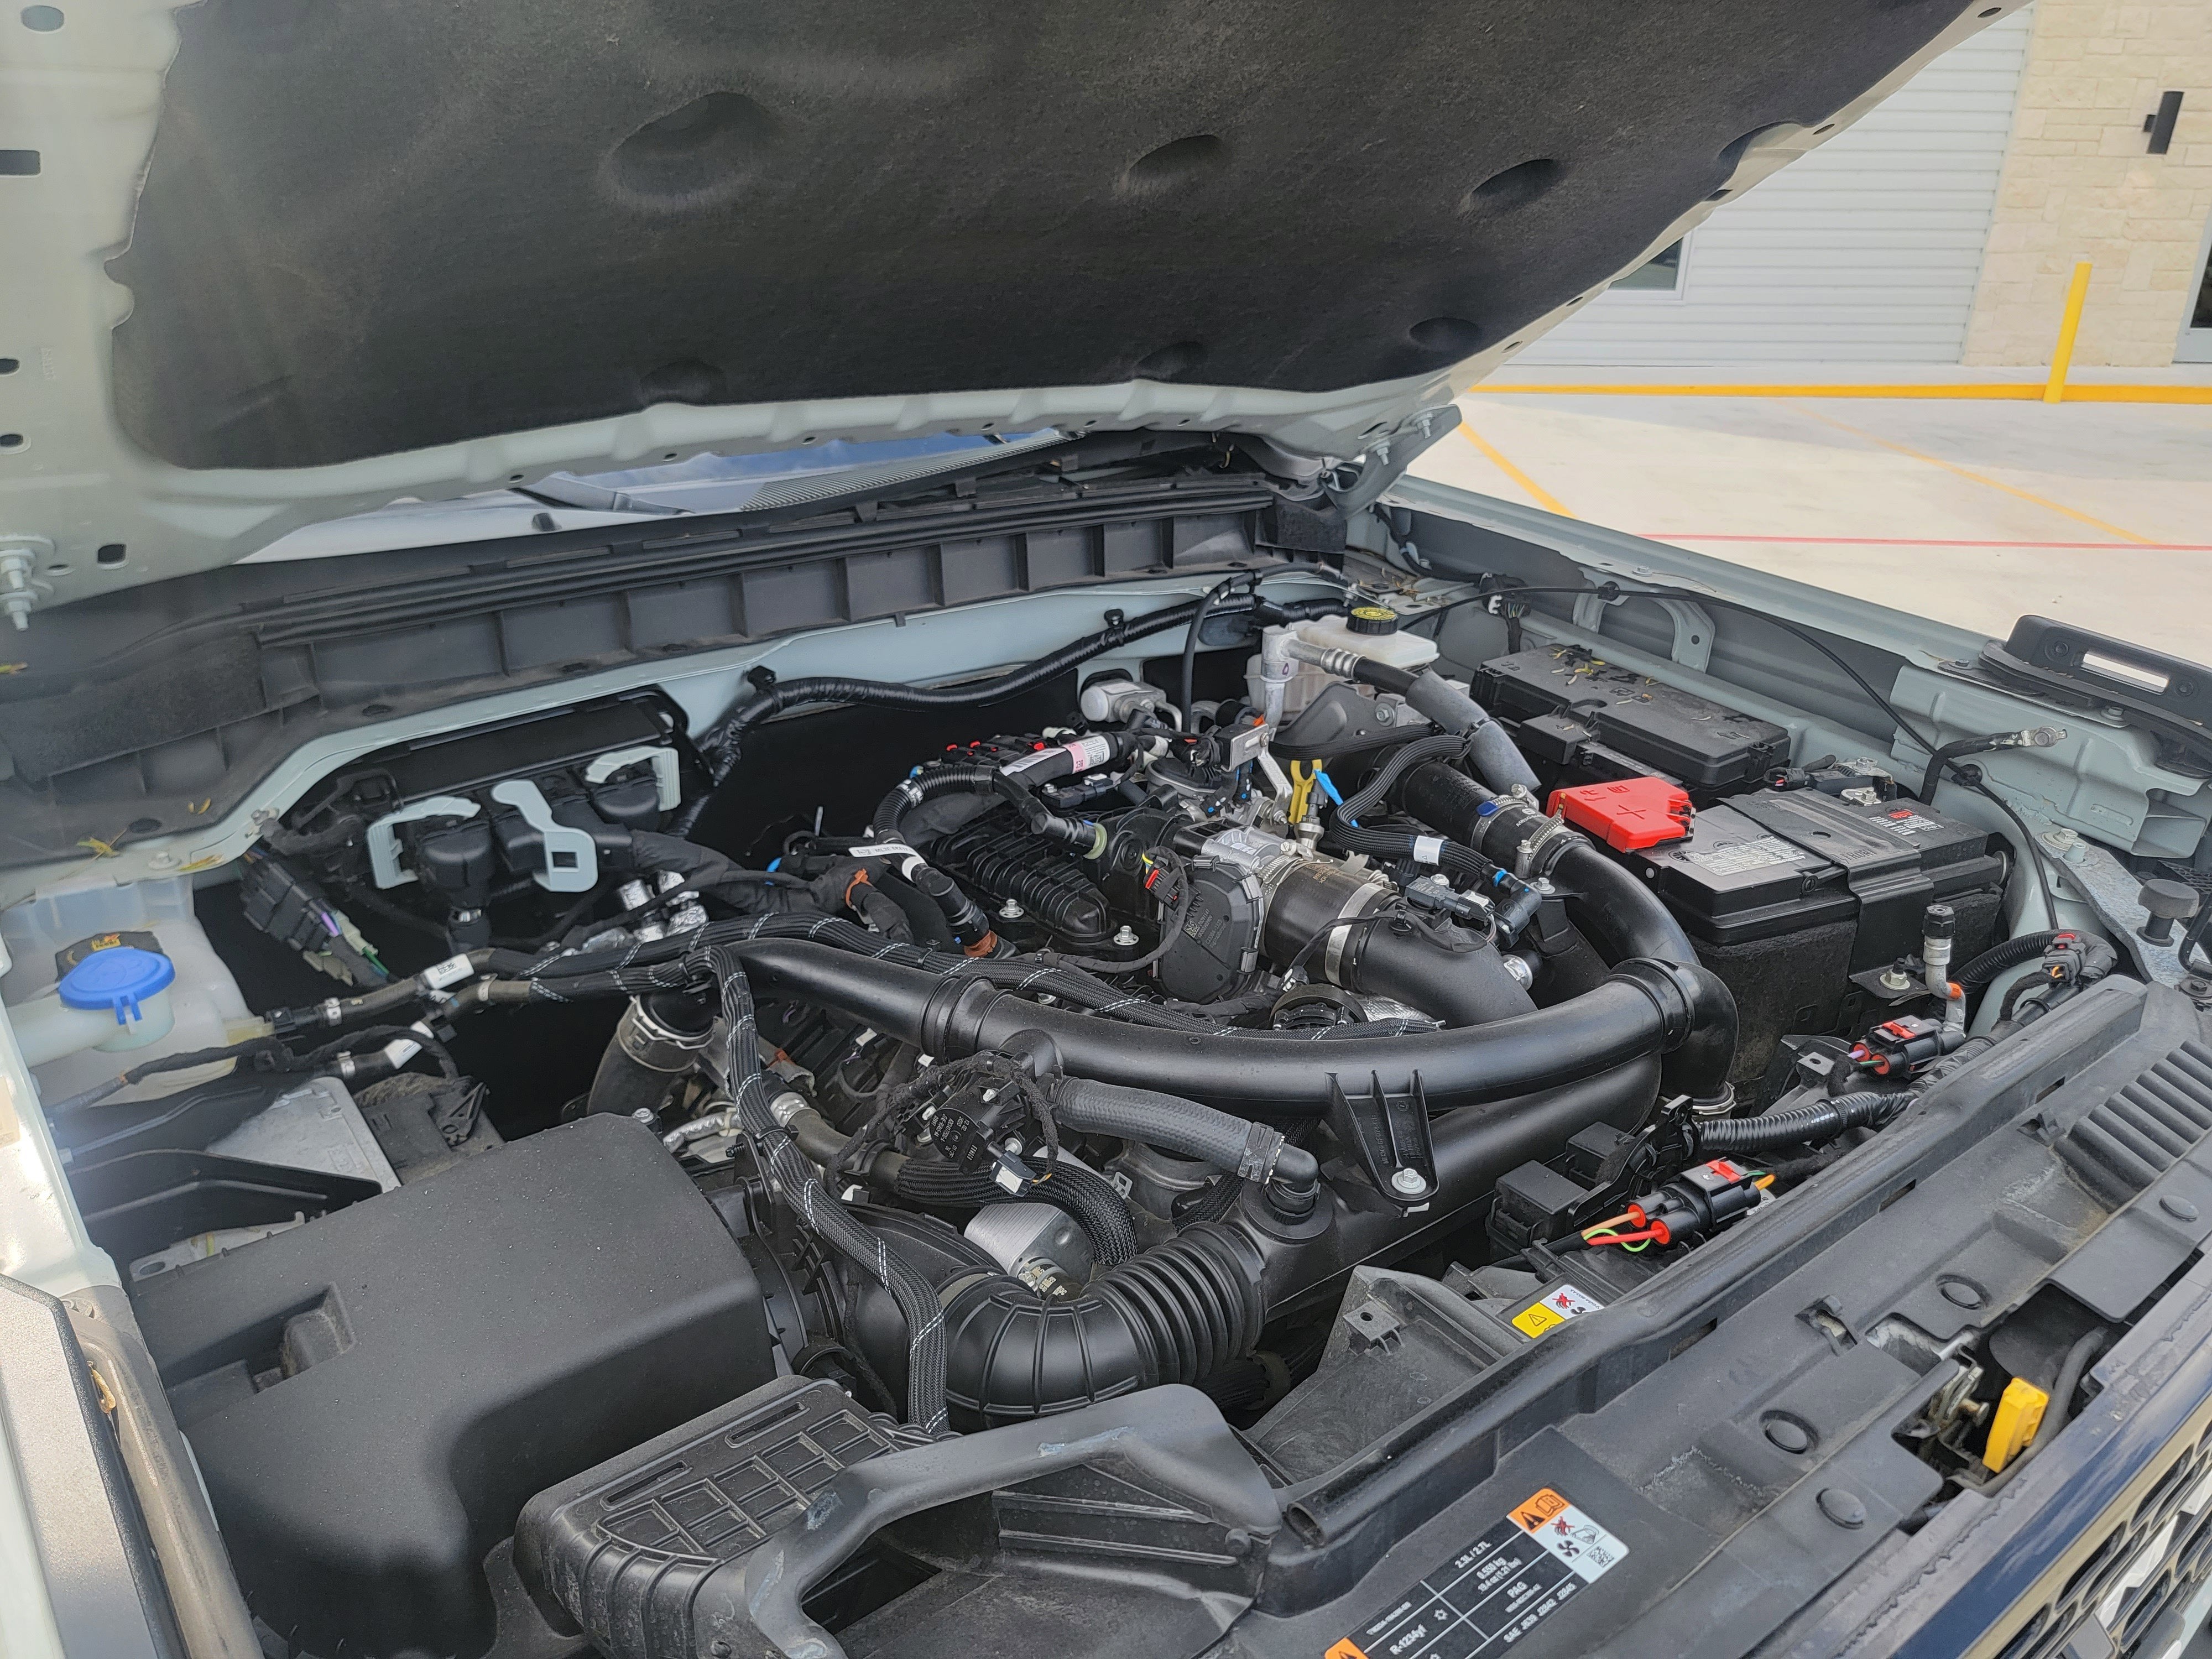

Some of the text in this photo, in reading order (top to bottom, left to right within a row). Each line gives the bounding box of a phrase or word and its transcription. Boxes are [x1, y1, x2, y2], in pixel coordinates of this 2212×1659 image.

[1455, 1552, 1474, 1568] 2.3L
[1473, 1541, 1491, 1554] 2.7L
[1493, 1557, 1509, 1569] kg
[1507, 1582, 1527, 1598] PAG
[1504, 1627, 1522, 1642] SAE
